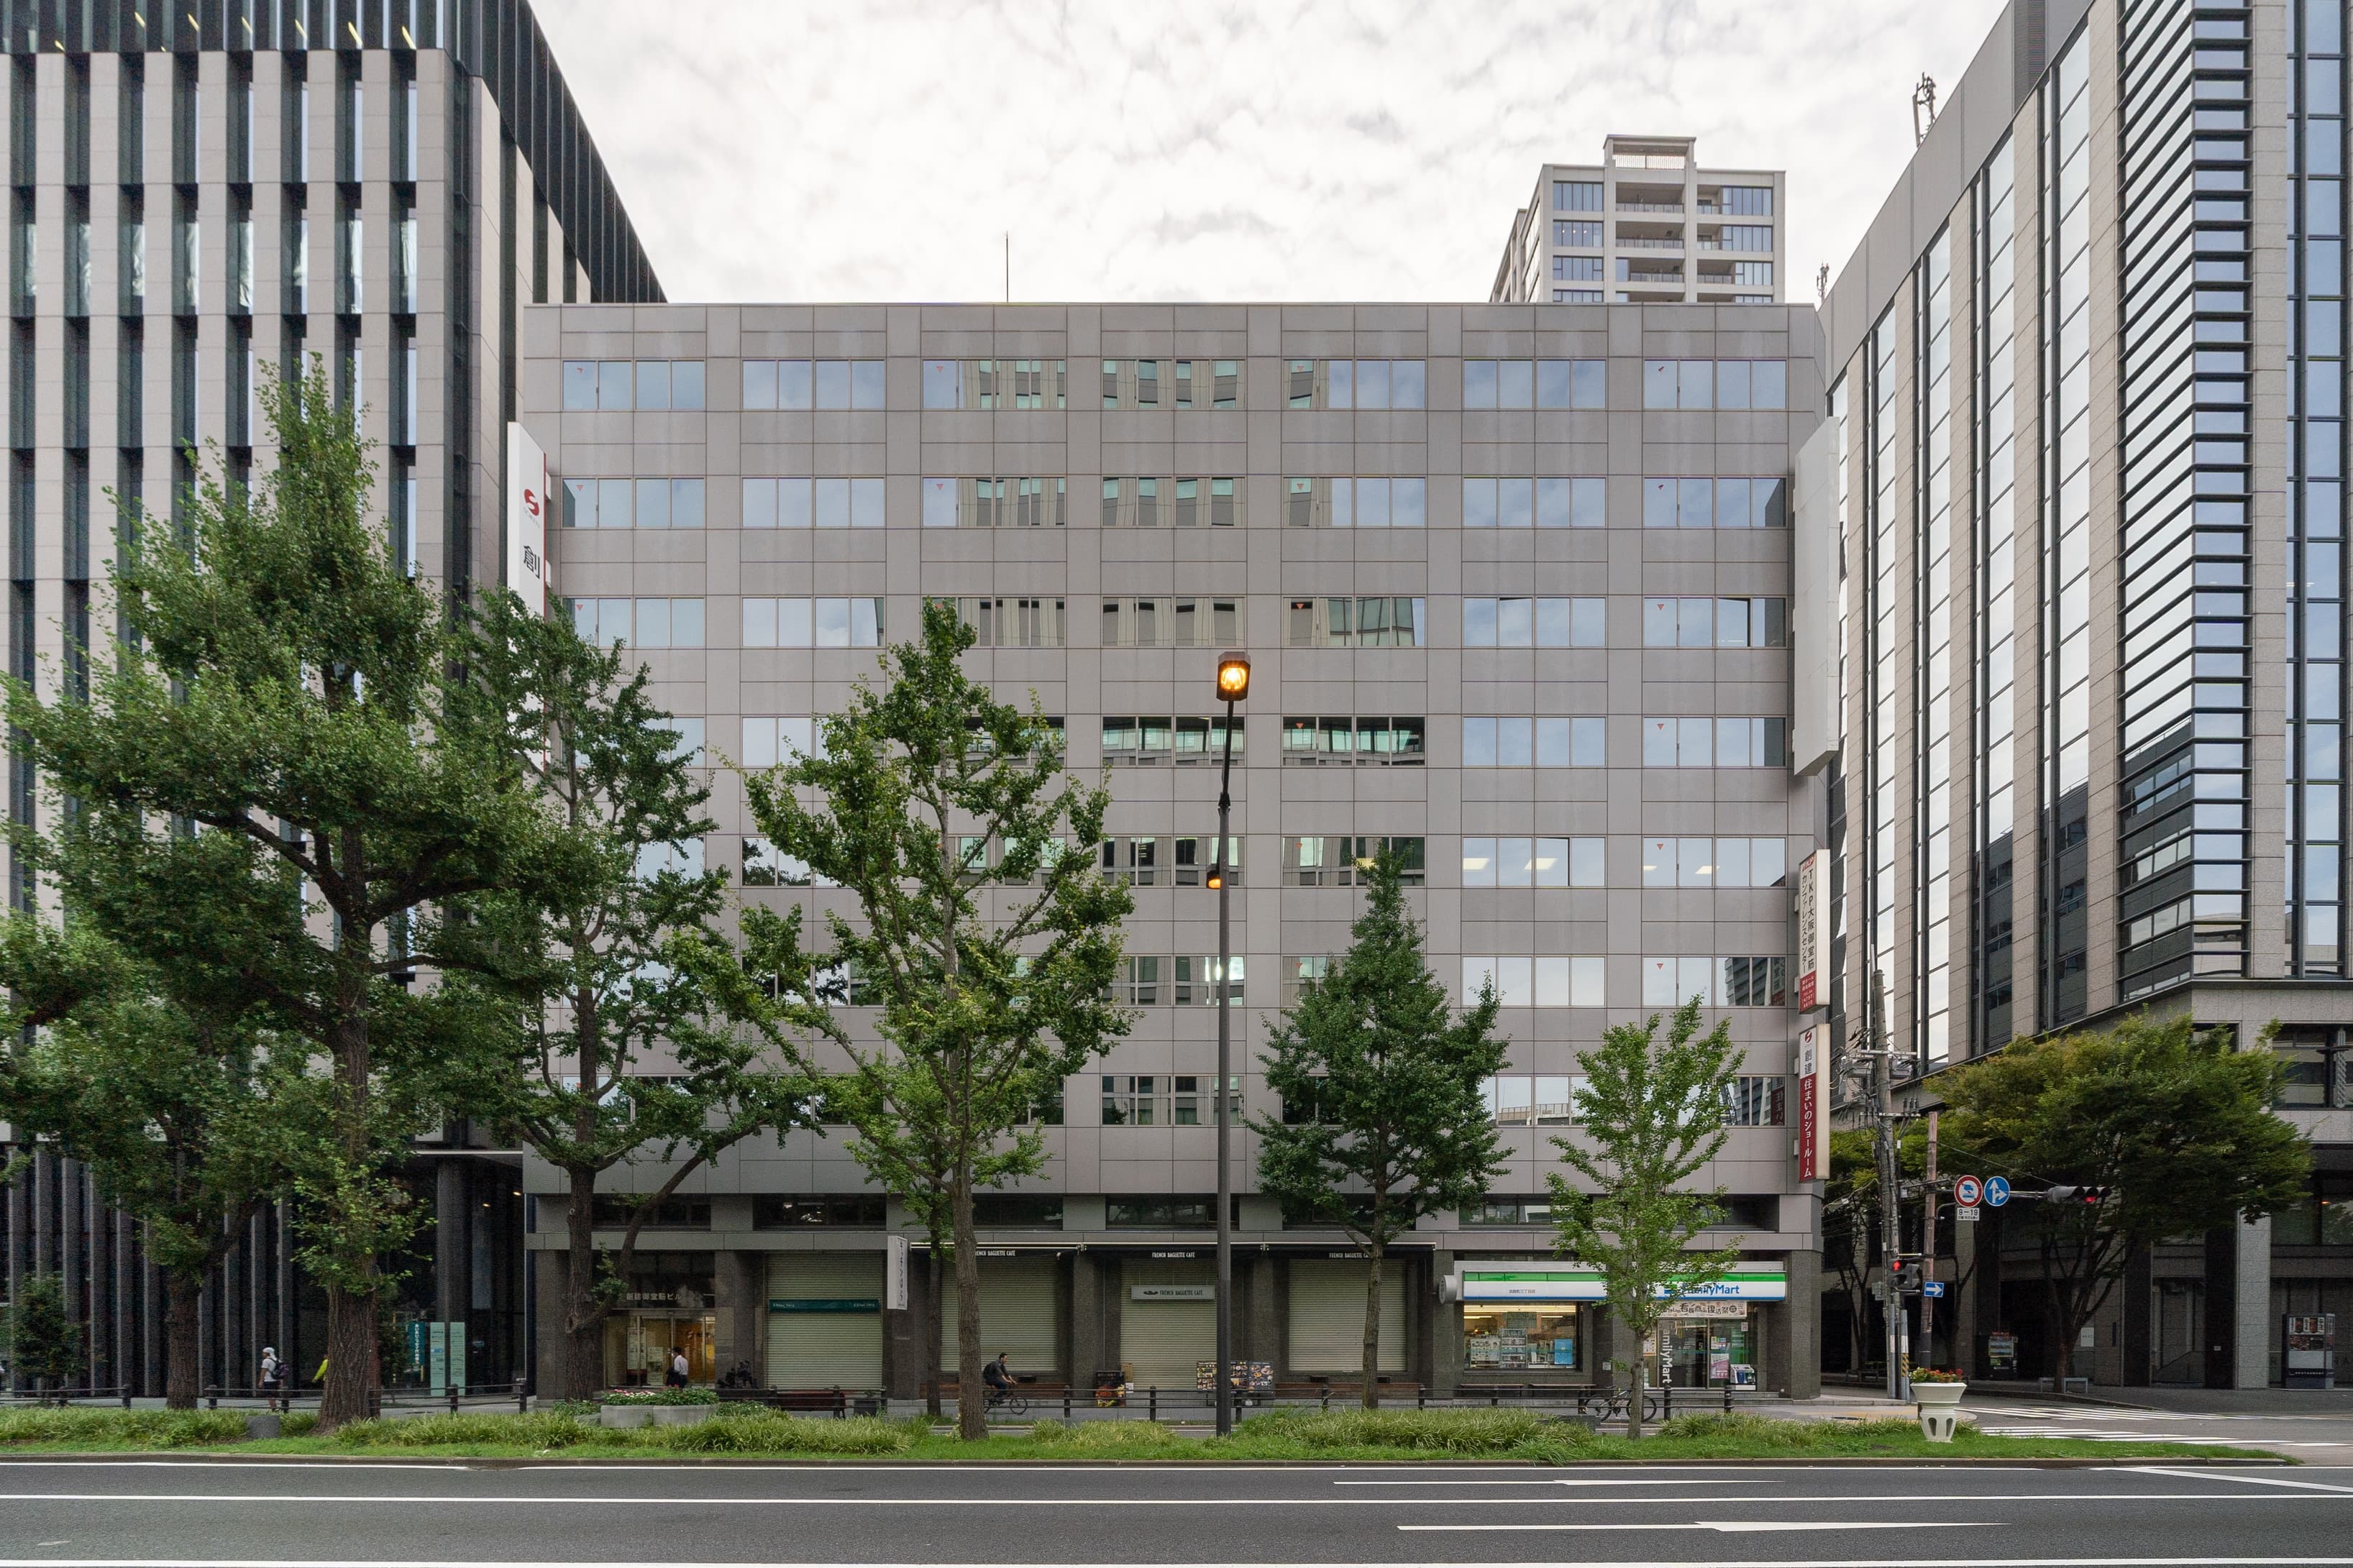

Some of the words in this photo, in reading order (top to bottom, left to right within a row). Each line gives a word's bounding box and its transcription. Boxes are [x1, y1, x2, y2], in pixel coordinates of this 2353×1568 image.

[524, 545, 540, 580] 創
[1804, 1078, 1813, 1178] 住まいのショールーム
[1660, 1326, 1673, 1384] amilyMart
